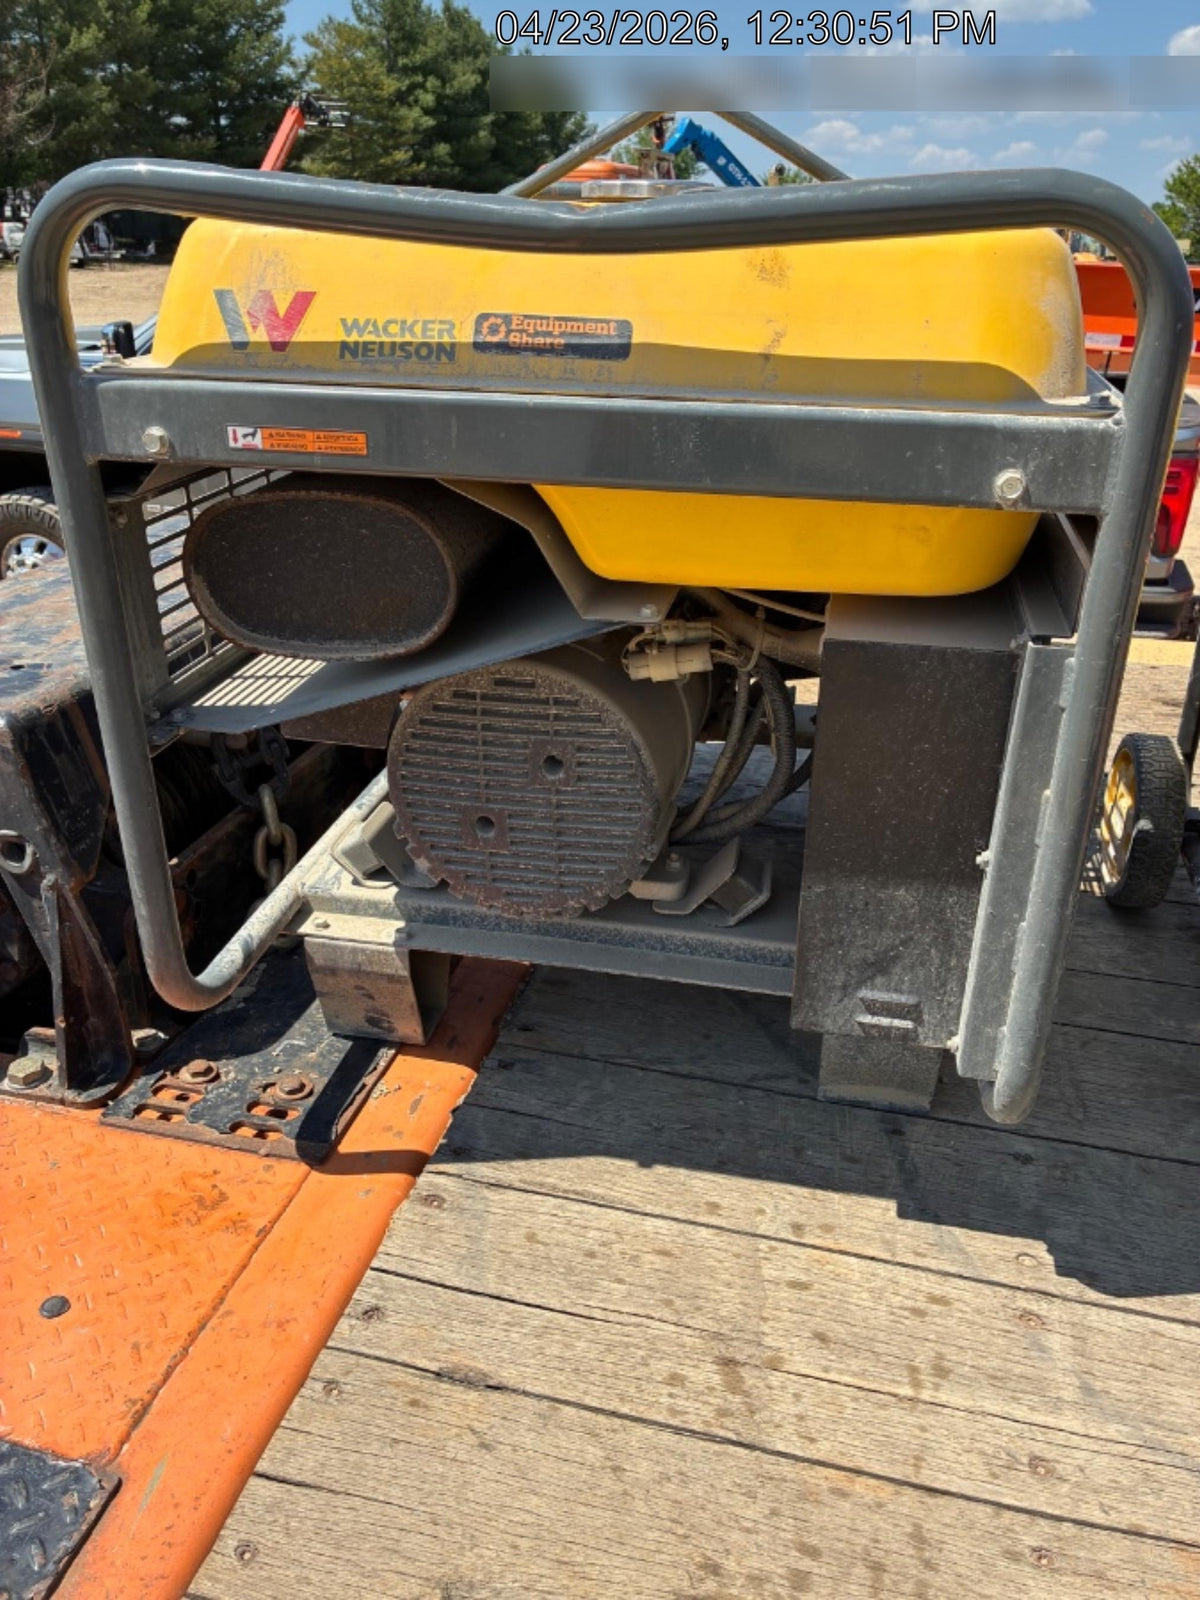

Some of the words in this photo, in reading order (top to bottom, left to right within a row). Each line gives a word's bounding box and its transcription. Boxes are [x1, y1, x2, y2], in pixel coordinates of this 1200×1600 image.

[339, 317, 457, 340] WACKER
[510, 314, 618, 335] Equipment
[338, 340, 457, 362] NEUSON
[508, 332, 566, 349] Share
